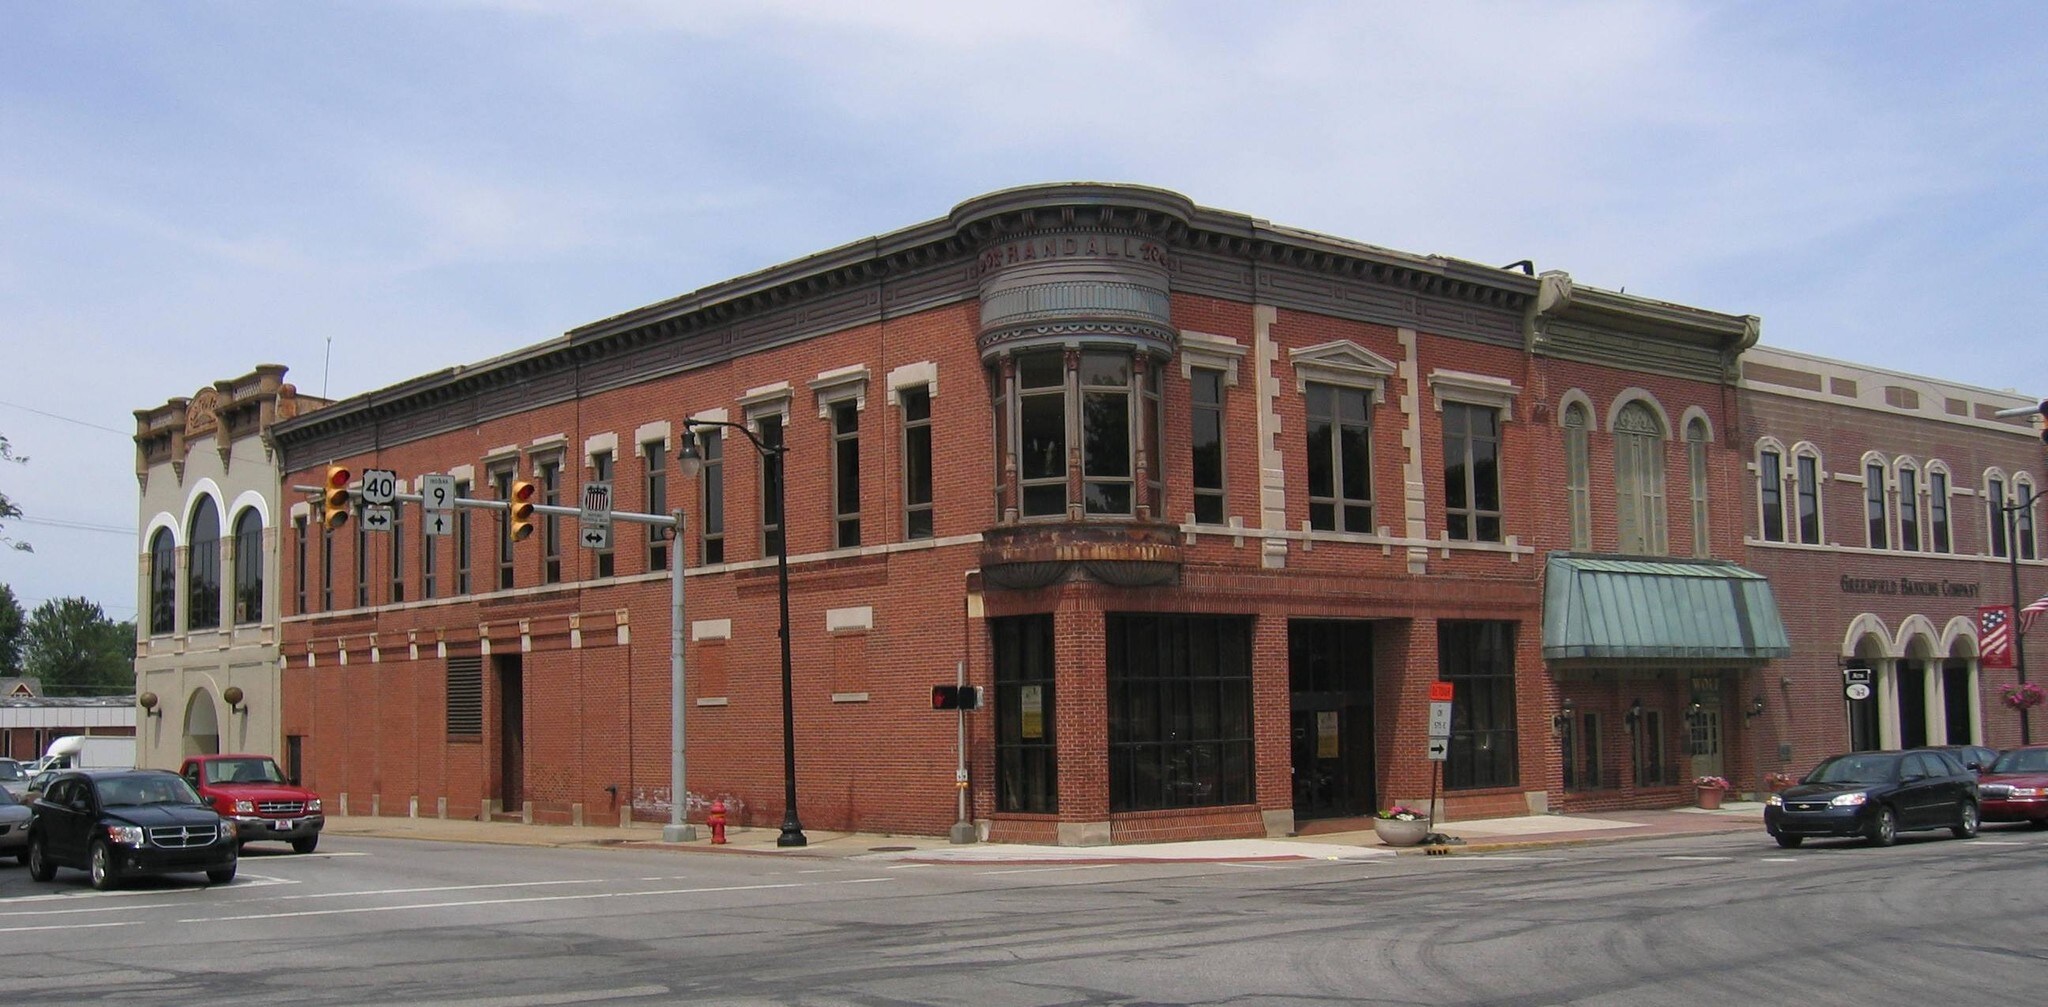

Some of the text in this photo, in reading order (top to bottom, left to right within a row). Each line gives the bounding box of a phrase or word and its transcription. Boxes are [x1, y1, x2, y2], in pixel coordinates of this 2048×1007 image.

[1008, 237, 1136, 263] RANDALL
[366, 478, 392, 497] 40
[434, 488, 445, 506] 9
[1841, 575, 1979, 597] GREENFIELD BANKING COMPANY
